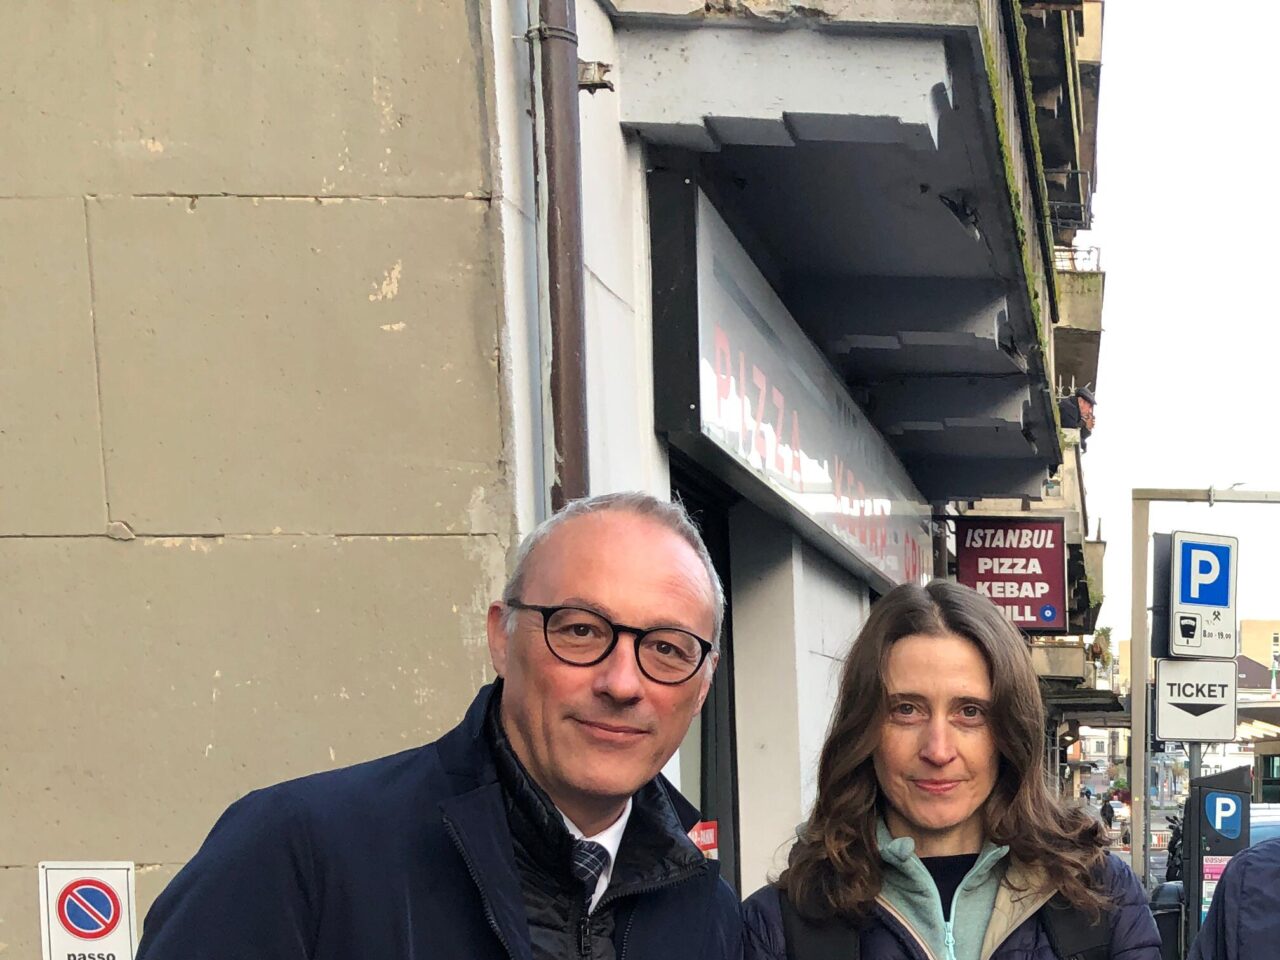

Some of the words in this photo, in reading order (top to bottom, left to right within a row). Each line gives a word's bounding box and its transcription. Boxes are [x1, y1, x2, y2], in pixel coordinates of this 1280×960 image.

[713, 322, 804, 492] PIZZA
[965, 528, 1055, 549] ISTANBUL
[977, 557, 1043, 575] PIZZA
[1190, 549, 1220, 599] P
[976, 581, 1050, 599] KEBAP
[995, 605, 1037, 621] ILL
[1166, 682, 1229, 699] TICKET
[1215, 797, 1237, 830] P
